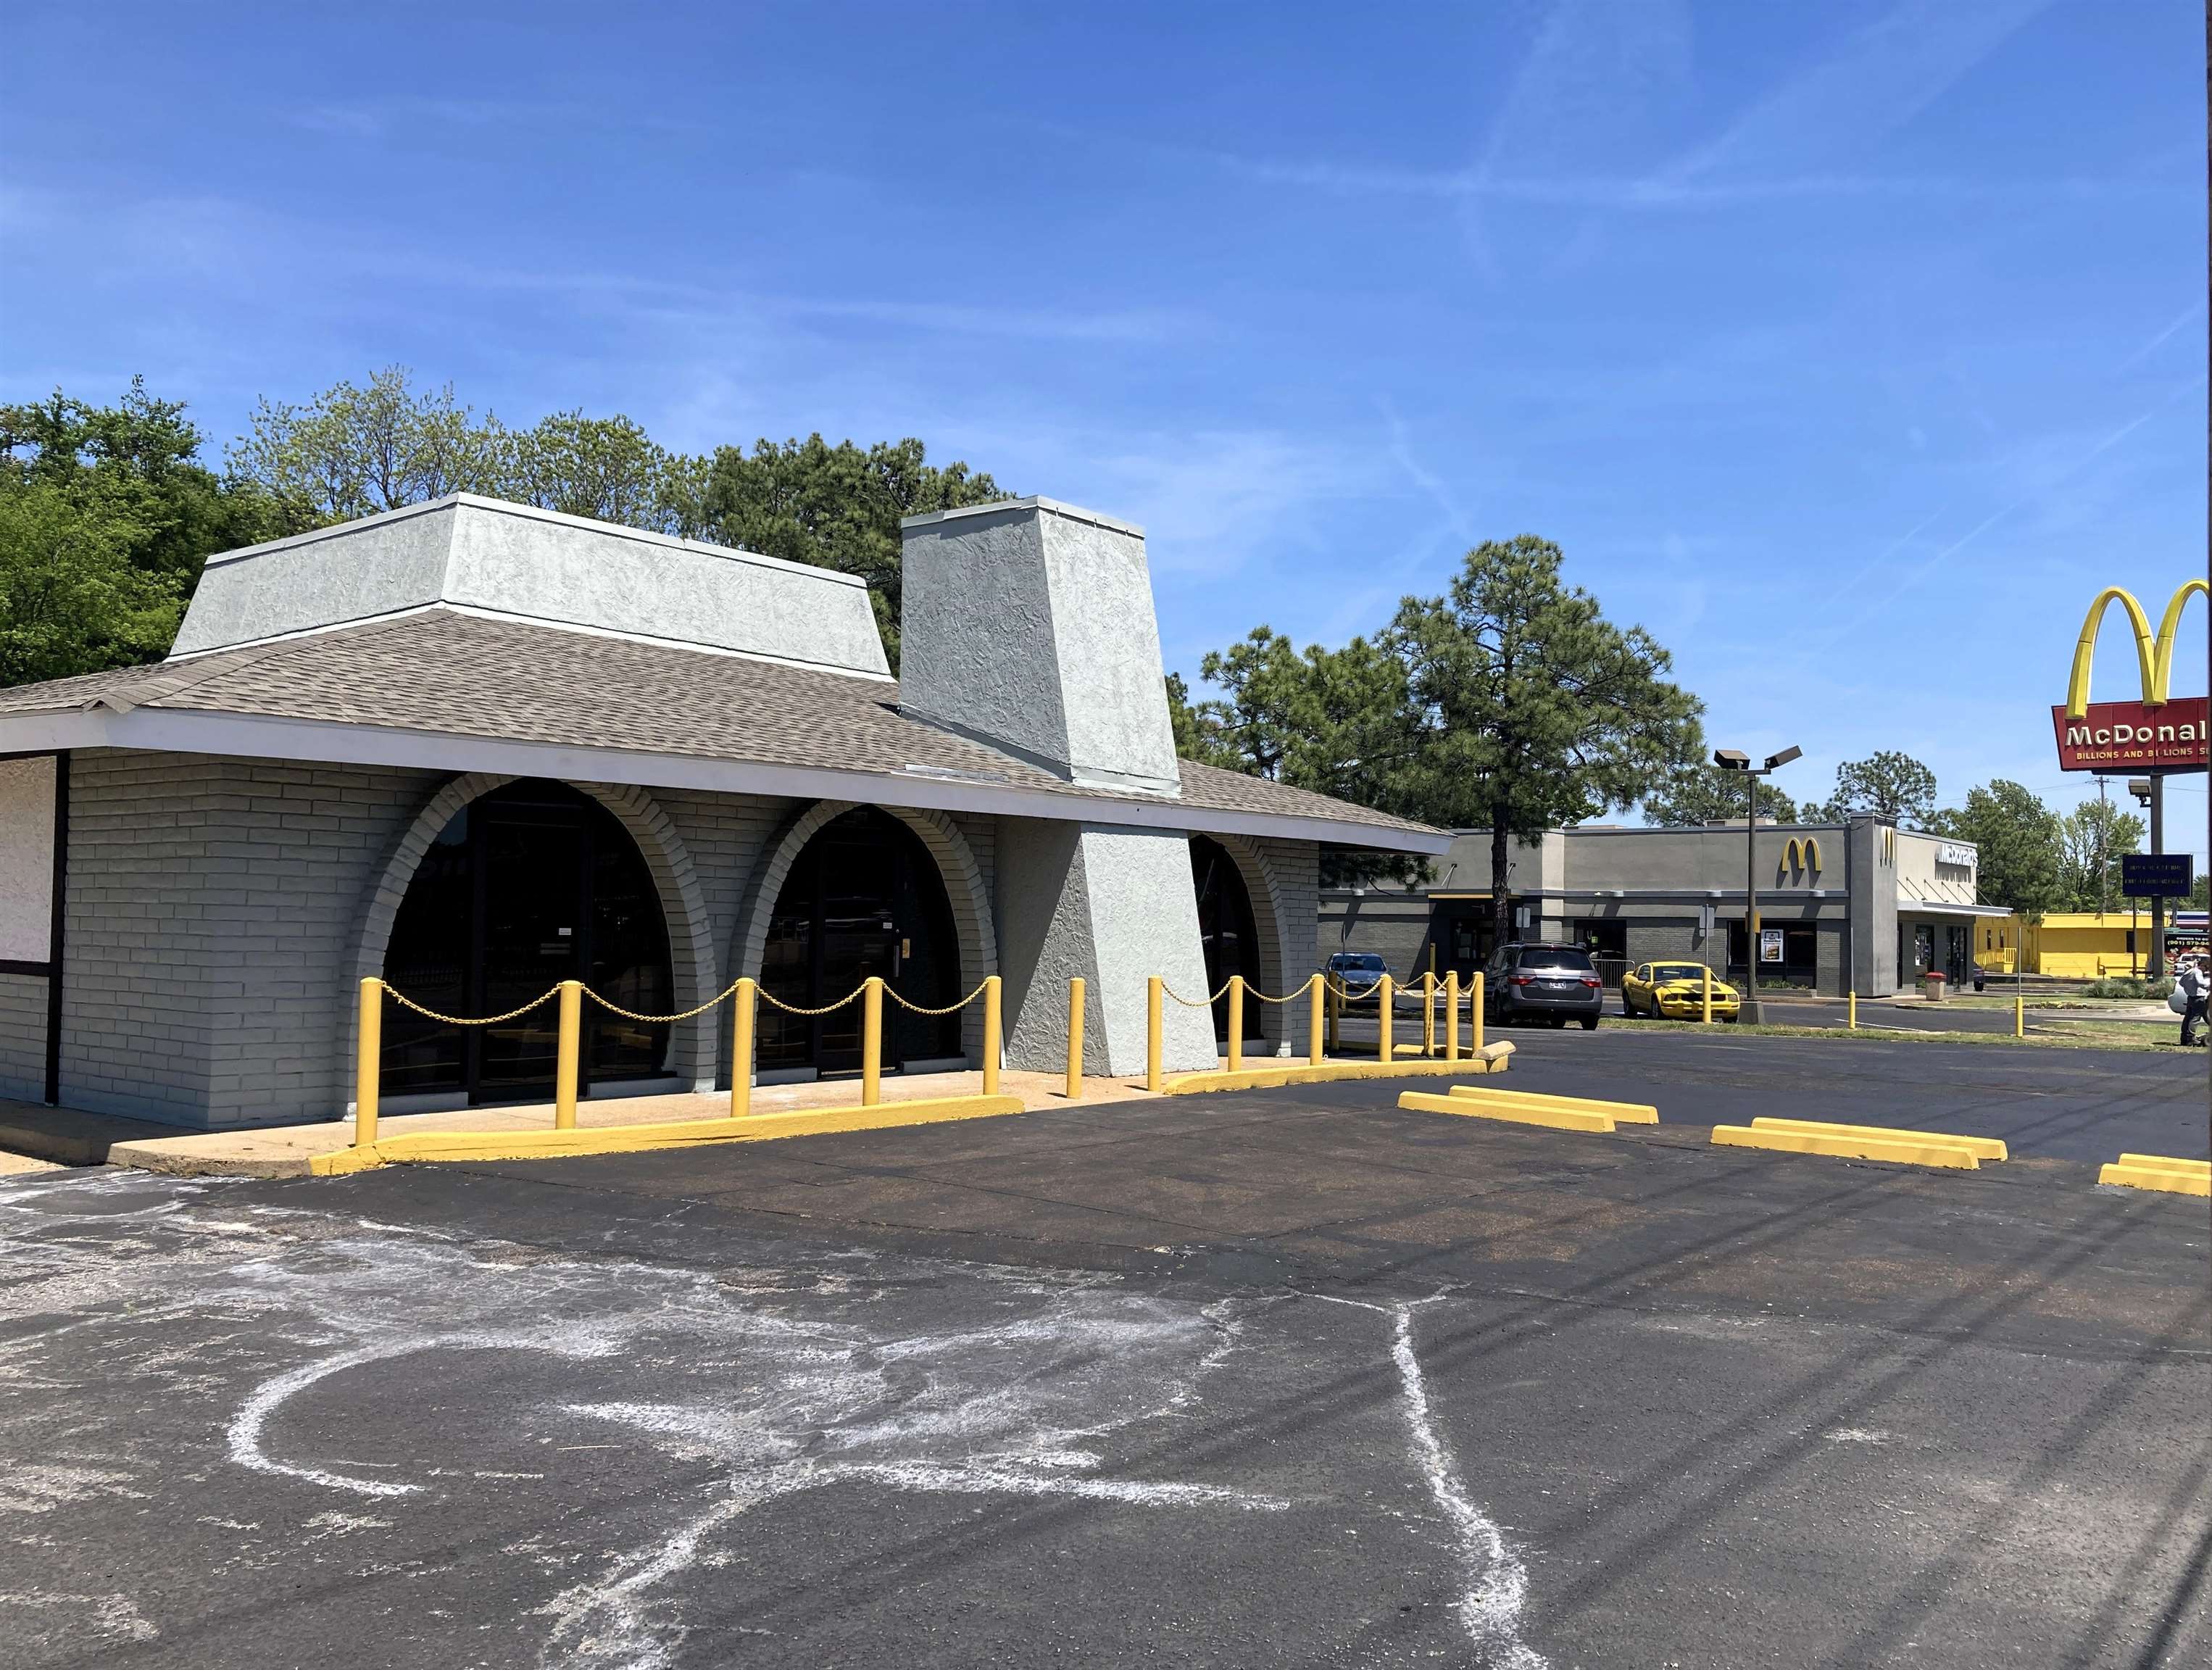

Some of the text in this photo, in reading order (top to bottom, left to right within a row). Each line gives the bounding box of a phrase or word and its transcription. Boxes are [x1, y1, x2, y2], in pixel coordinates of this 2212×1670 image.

[2065, 720, 2206, 746] McDonal
[2076, 751, 2119, 760] BILLIONS
[1939, 844, 1978, 868] McDonald's
